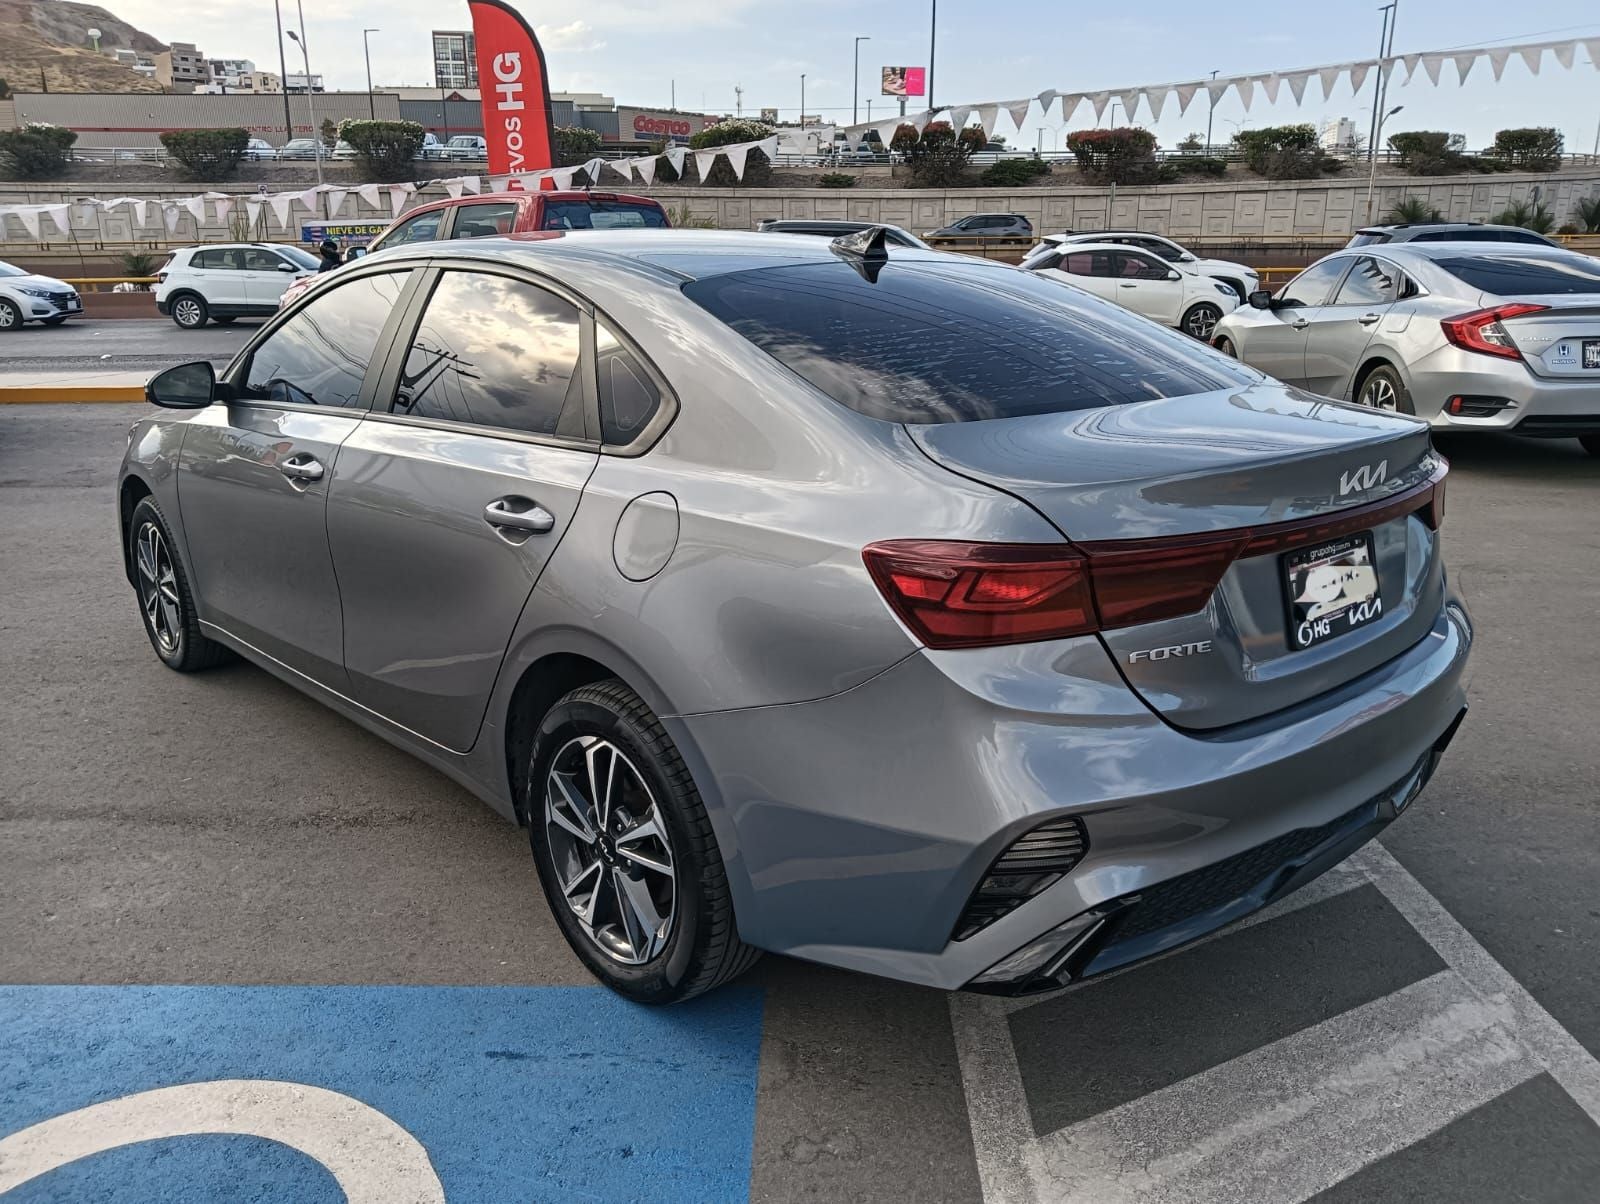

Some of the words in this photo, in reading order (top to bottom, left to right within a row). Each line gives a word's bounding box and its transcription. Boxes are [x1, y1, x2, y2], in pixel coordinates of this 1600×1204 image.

[492, 52, 525, 111] HG
[326, 226, 353, 235] NIEVE
[354, 226, 368, 234] DE
[1340, 459, 1388, 496] KIA
[1313, 618, 1331, 639] HG
[1348, 598, 1382, 625] KIA
[1129, 640, 1212, 664] FORTE
